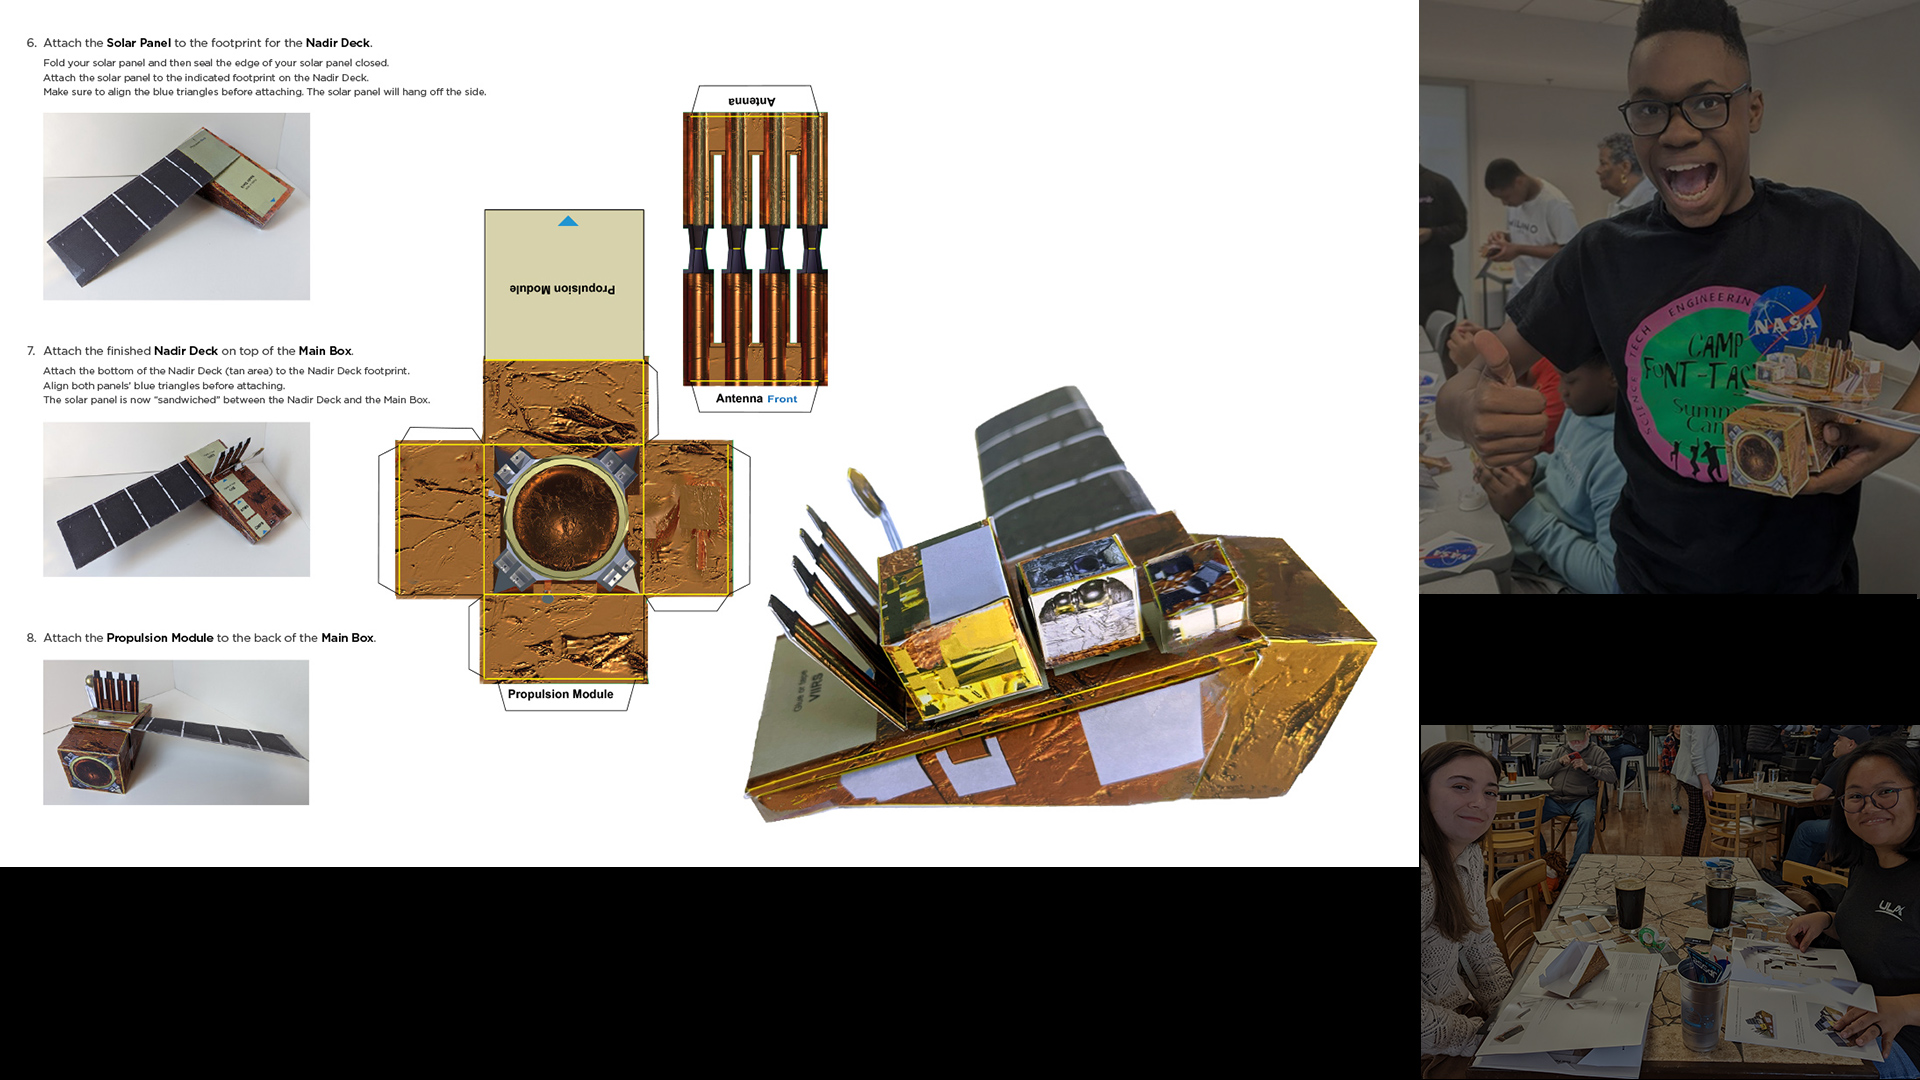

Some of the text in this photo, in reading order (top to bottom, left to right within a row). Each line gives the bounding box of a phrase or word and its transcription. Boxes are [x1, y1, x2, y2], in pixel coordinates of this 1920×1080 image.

[26, 37, 373, 50] 6. Attach the Solar Panel to the footprint for the Nadir Deck.
[43, 57, 390, 69] Fold your solar panel and then seal the edge of your solar panel closed.
[42, 72, 370, 84] Attach the solar panel to the indicated footprint on the Nadir Deck.
[43, 86, 487, 98] Make sure to align the blue triangles before attaching. The solar panel will hang off the side.
[727, 96, 777, 108] Antenna
[509, 282, 616, 296] Propulsion Module
[1668, 292, 1752, 317] ENGINEERIN
[1754, 314, 1819, 337] NASA
[1630, 325, 1651, 358] TECH
[1687, 331, 1745, 359] CAMP
[26, 345, 354, 358] 7. Attach the finished Nadir Deck on top of the Main Box.
[42, 366, 411, 377] Attach the bottom of the Nadir Deck (tan area) to the Nadir Deck footprint.
[42, 380, 69, 392] Align
[71, 381, 96, 391] both
[133, 381, 156, 391] blue
[157, 380, 201, 392] triangles
[202, 381, 235, 391] before
[236, 381, 286, 392] attaching.
[42, 395, 62, 405] The
[64, 395, 89, 405] solar
[90, 394, 118, 406] panel
[119, 395, 128, 405] is
[129, 397, 152, 405] now
[222, 395, 266, 405] between
[268, 395, 285, 405] the
[287, 395, 314, 405] Nadir
[316, 395, 342, 405] Deck
[343, 395, 363, 405] and
[364, 395, 382, 405] the
[383, 395, 407, 405] Main
[409, 395, 431, 405] Box.
[715, 392, 798, 404] Antenna Front
[1630, 376, 1652, 435] SCIENCE
[1673, 398, 1739, 420] Summ
[1433, 549, 1471, 561] NASA
[26, 632, 377, 645] 8. Attach the Propulsion Module to the back of the Main Box.
[808, 672, 824, 703] VIIRS
[507, 688, 615, 702] Propulsion Module
